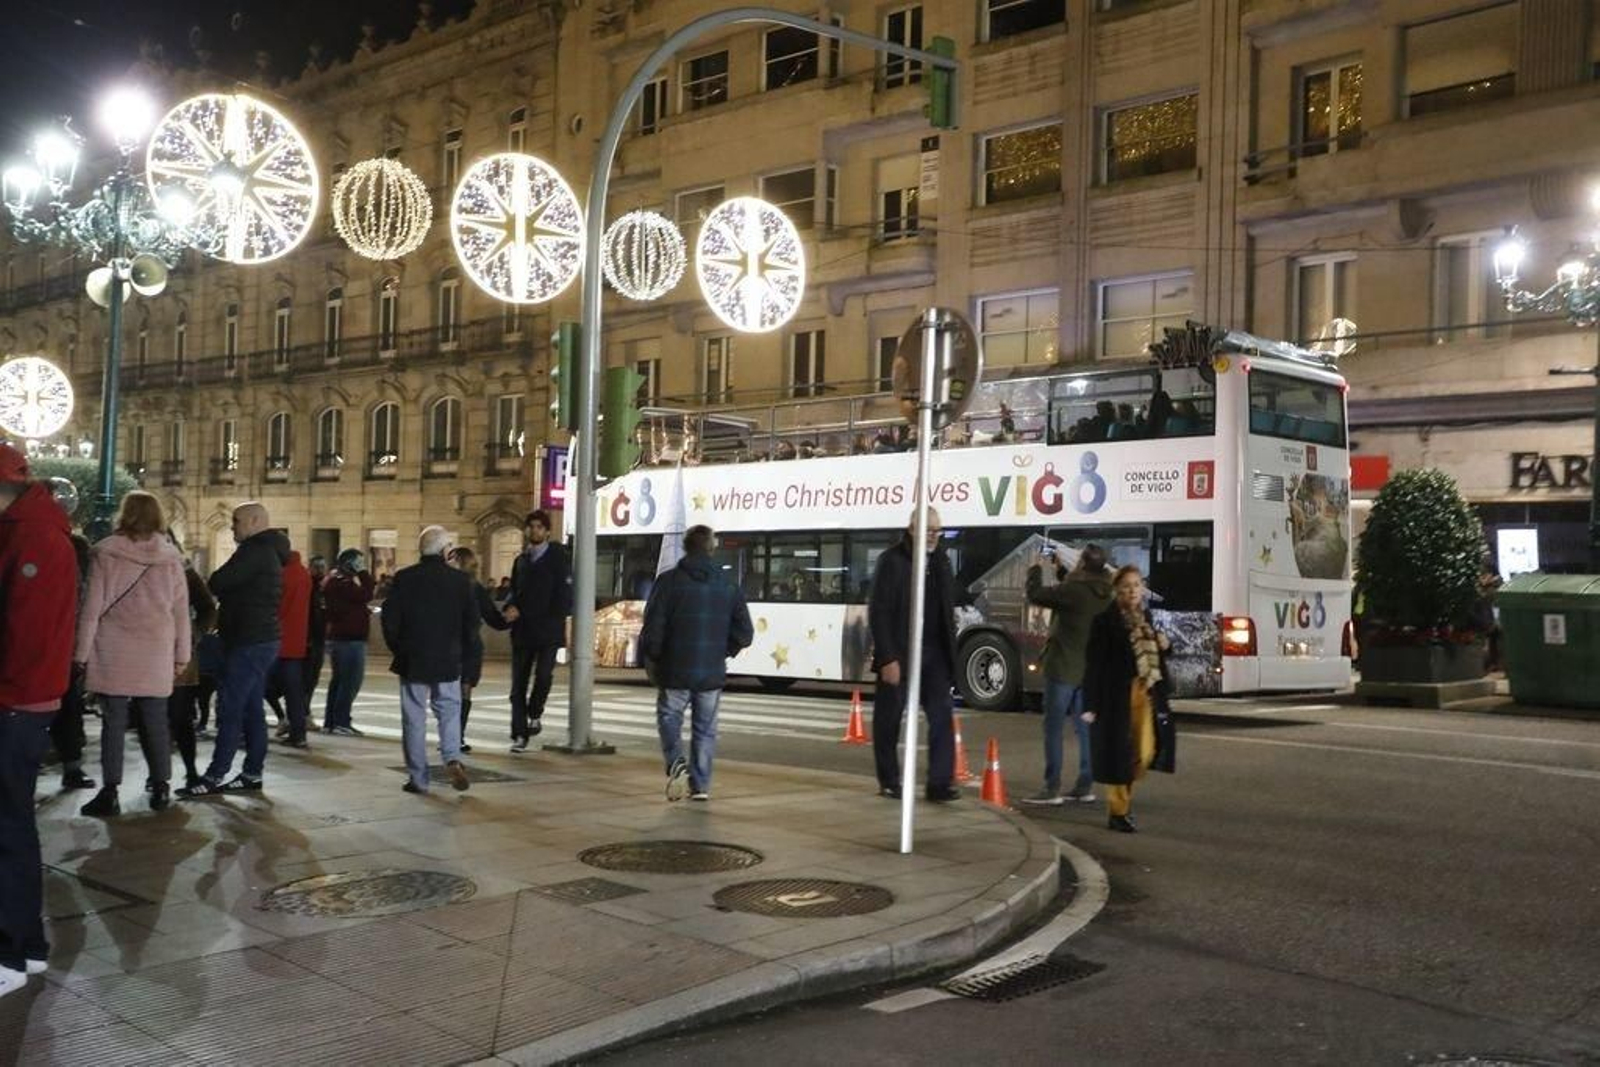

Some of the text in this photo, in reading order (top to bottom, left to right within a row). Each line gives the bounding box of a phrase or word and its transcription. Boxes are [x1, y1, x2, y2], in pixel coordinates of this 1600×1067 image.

[1125, 469, 1180, 482] CONCELLO
[1130, 482, 1173, 493] DE VIGO
[1510, 452, 1595, 488] FAR
[601, 451, 1107, 527] IGO where Christmas lves VIGO
[1274, 591, 1326, 629] VIGO
